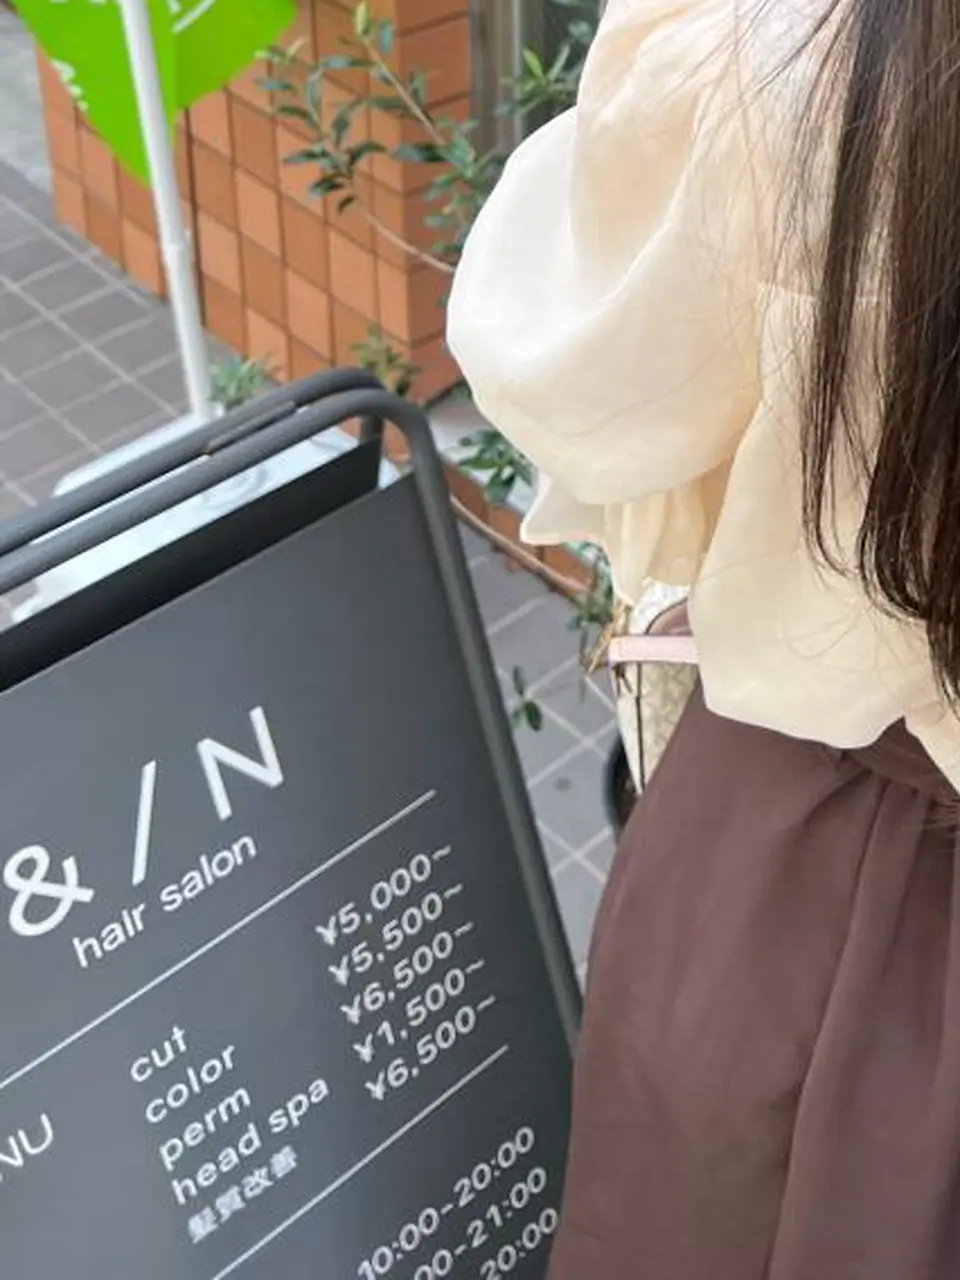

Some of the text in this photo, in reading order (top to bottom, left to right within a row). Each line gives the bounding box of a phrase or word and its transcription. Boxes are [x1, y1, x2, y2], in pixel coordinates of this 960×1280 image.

[72, 835, 257, 968] hair salon
[130, 1026, 187, 1083] cut
[145, 1044, 235, 1123] color
[159, 1087, 251, 1172] perm
[171, 1078, 329, 1205] head spa
